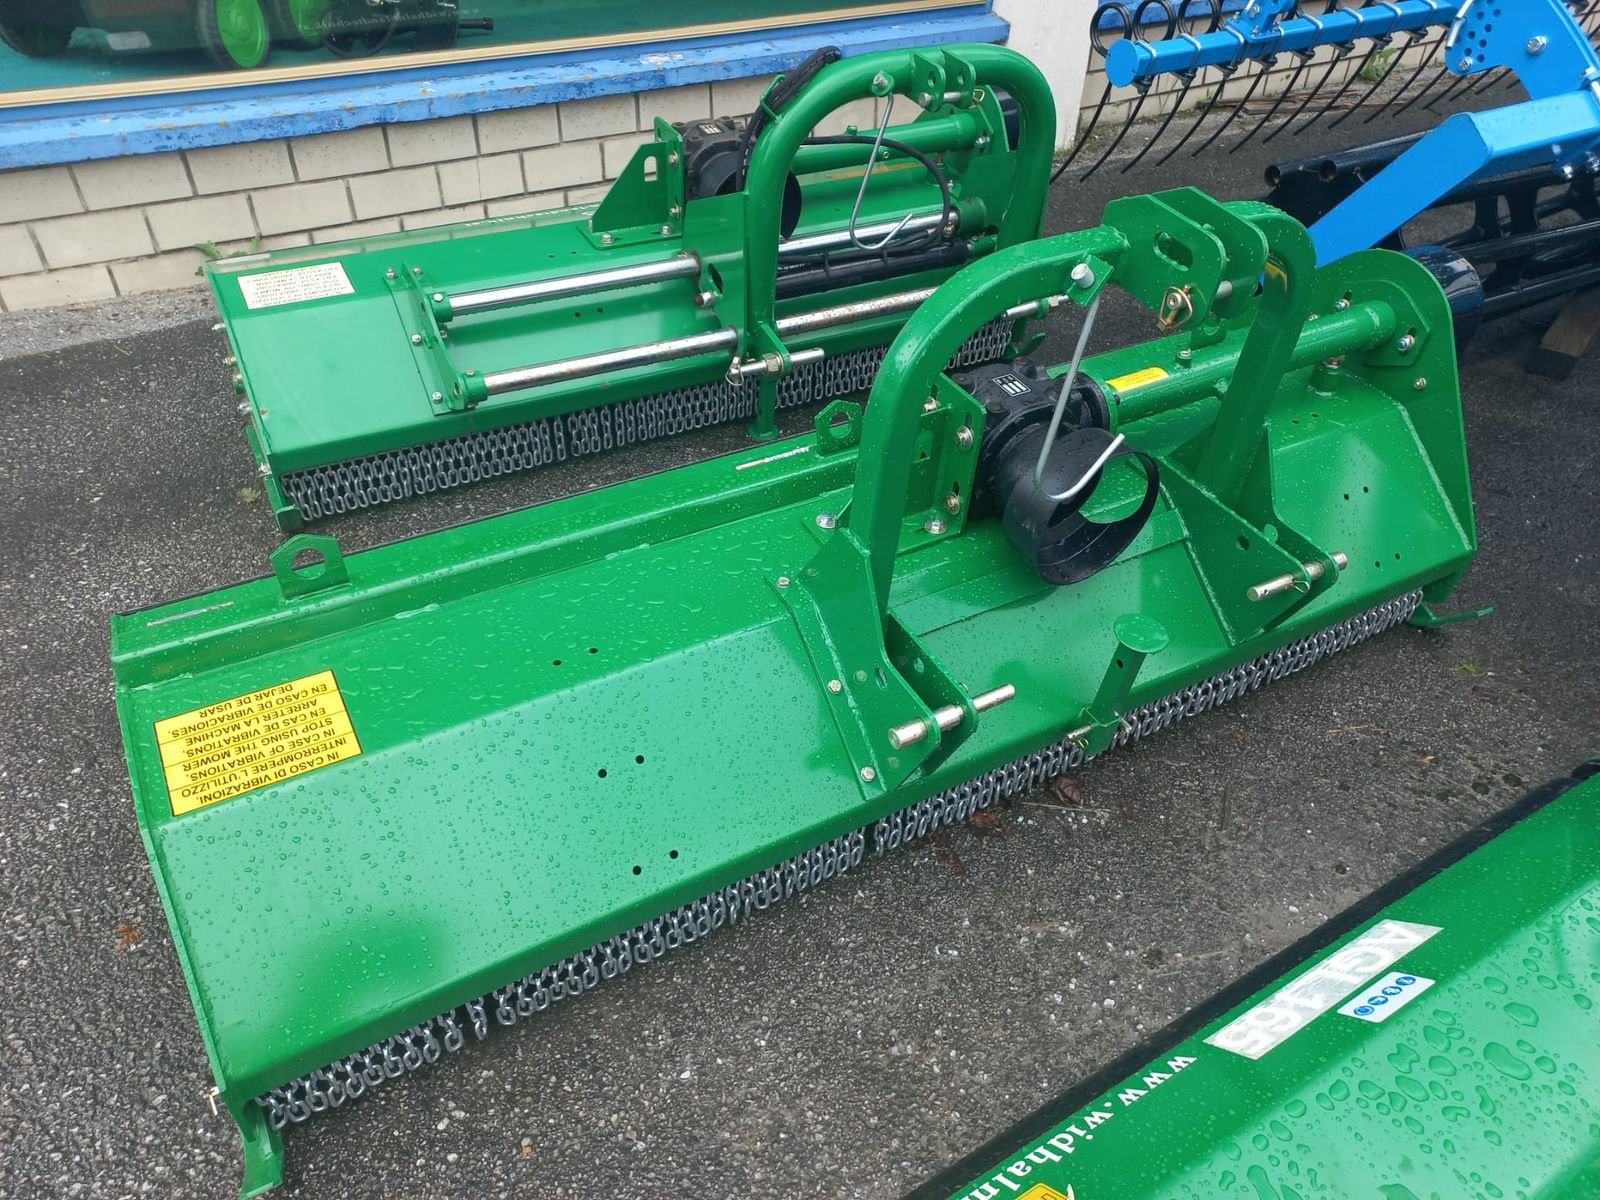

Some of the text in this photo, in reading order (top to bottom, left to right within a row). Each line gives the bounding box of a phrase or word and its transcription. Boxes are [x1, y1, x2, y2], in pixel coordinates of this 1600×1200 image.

[168, 684, 327, 738] EN CASO DE VIBRACIONES.
[185, 699, 318, 746] ARRETER LA MACHINE
[199, 684, 293, 718] DEJAR DE USAR
[182, 707, 326, 756] EN CAS DE VIBRATIONS.
[182, 718, 333, 771] STOP USING THE MOWER
[186, 728, 335, 781] IN CASE OF VIBRATIONS.
[181, 738, 347, 797] INTERROMPERE L'UTILIZZO
[196, 752, 340, 804] IN CASO DI VIBRAZIONI.
